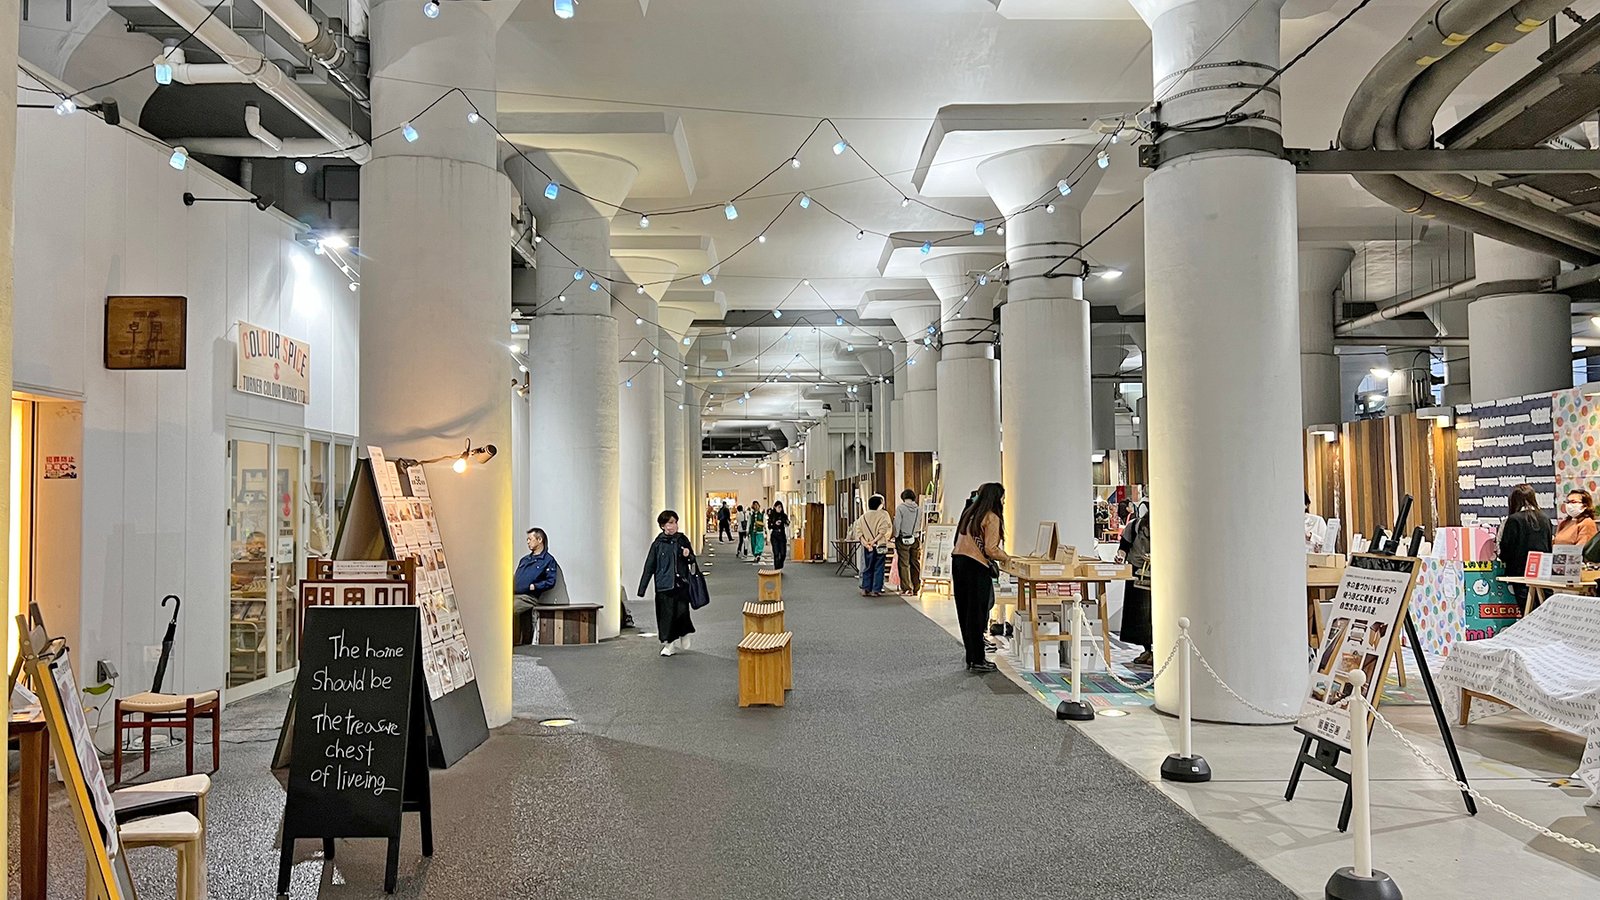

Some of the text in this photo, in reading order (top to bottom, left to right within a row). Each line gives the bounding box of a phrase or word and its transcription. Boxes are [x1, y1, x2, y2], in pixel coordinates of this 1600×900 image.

[242, 330, 307, 378] COLOUR SPICE
[329, 629, 404, 659] The home
[370, 668, 392, 690] be
[312, 702, 400, 736] The treasure
[325, 738, 374, 766] chest
[310, 764, 399, 796] of liveing
